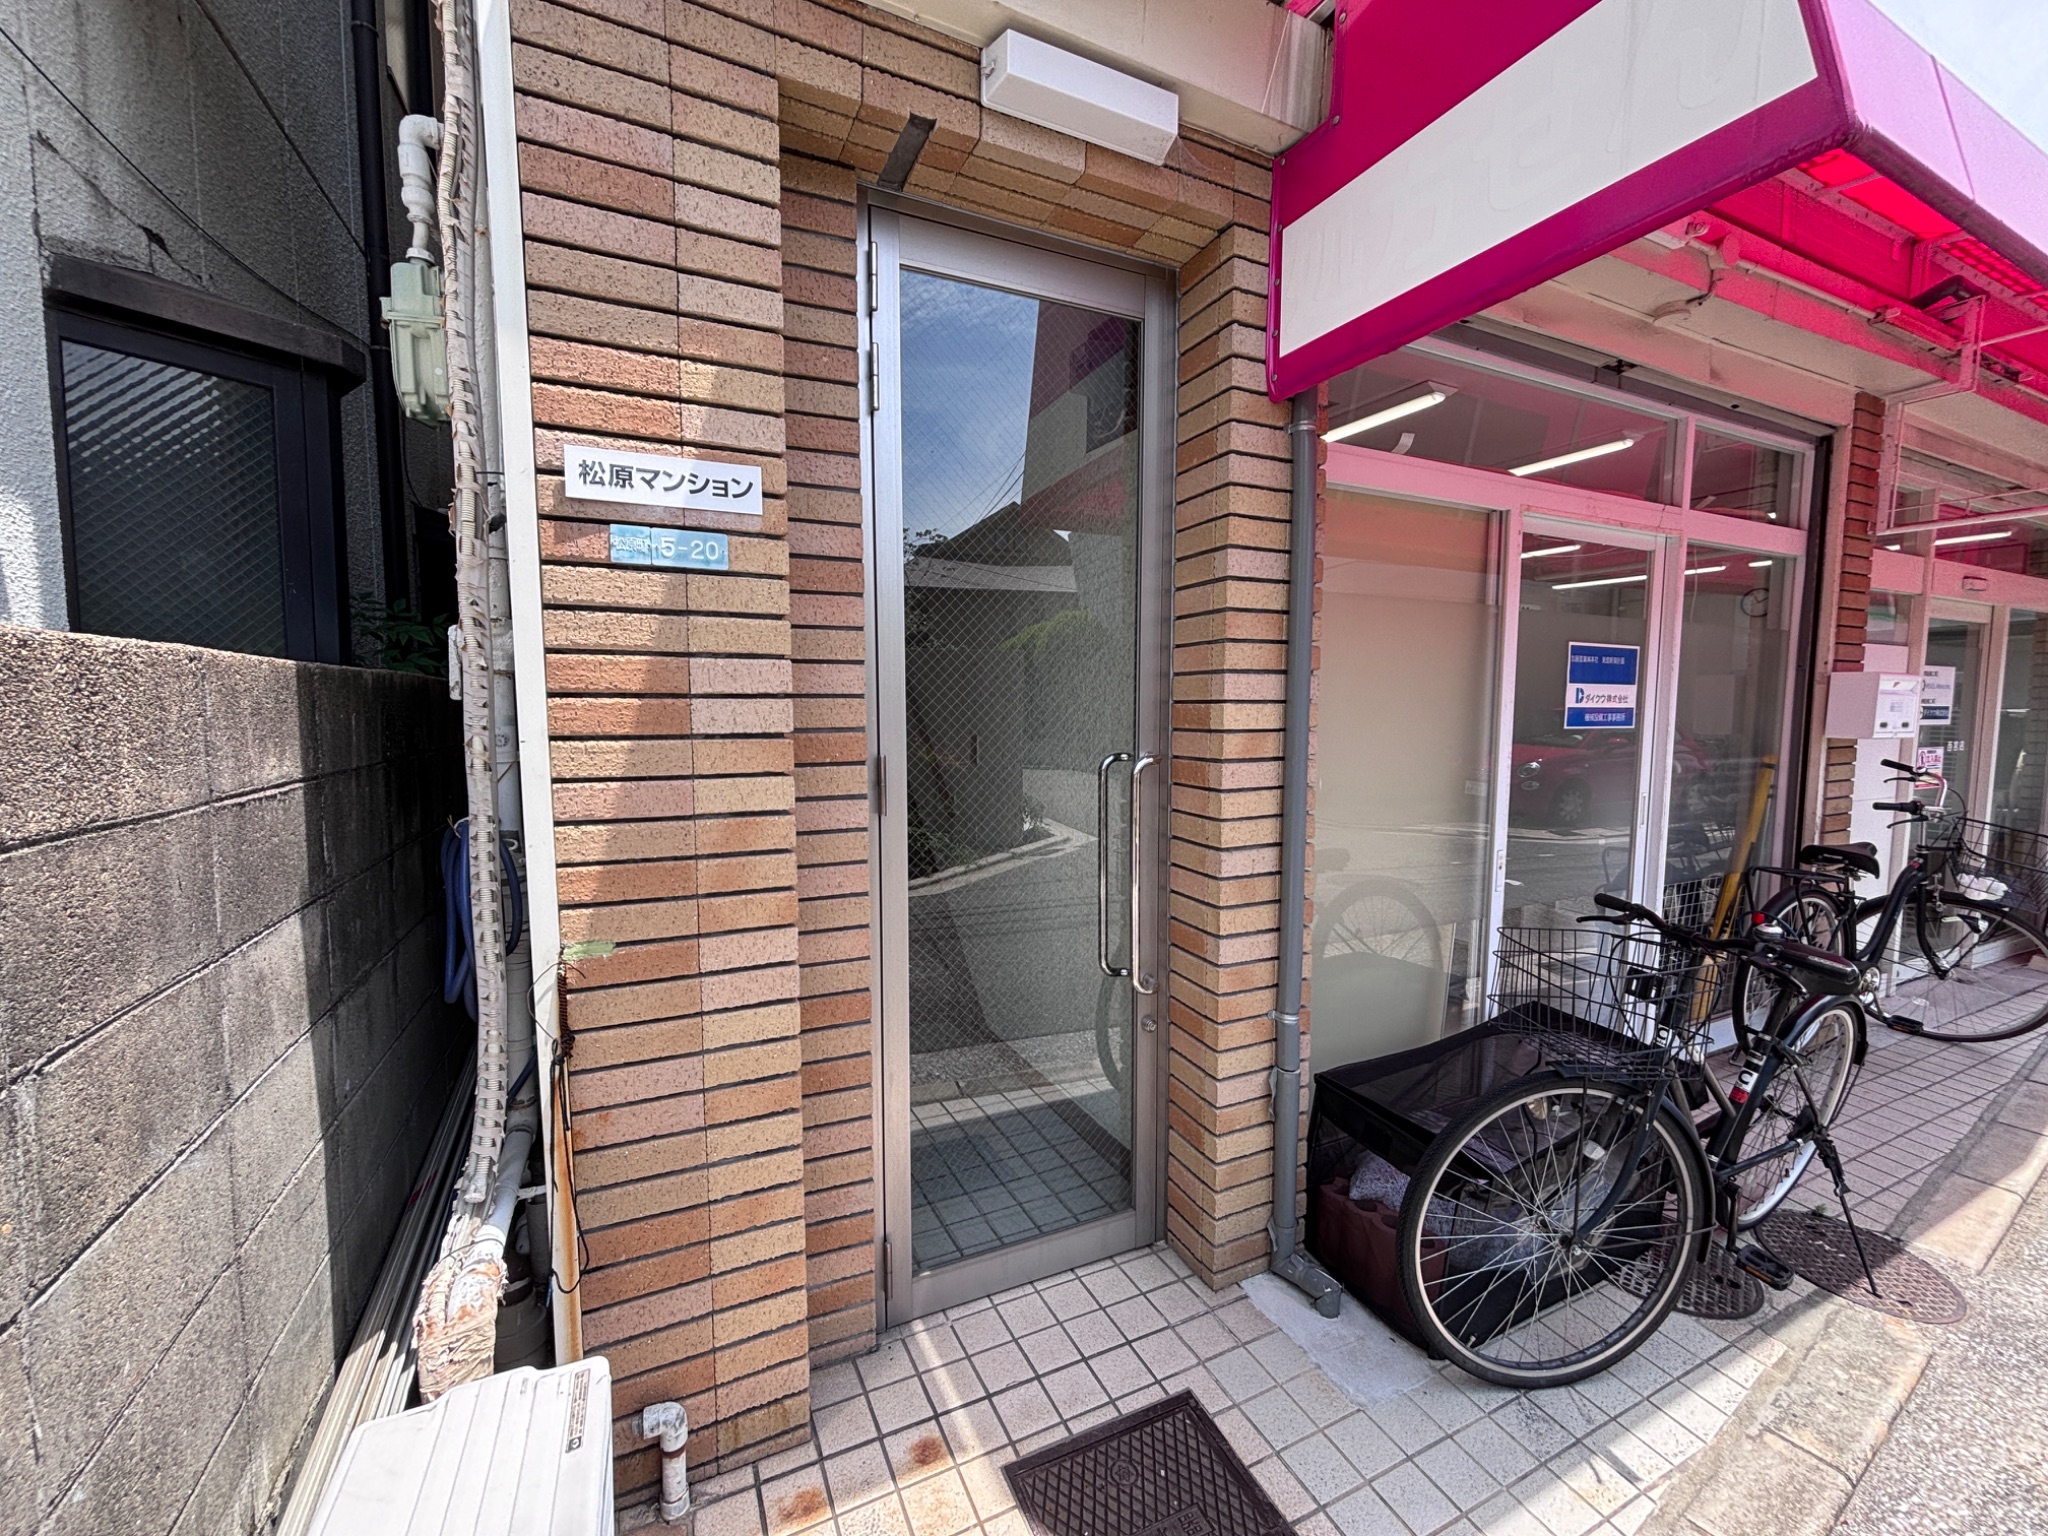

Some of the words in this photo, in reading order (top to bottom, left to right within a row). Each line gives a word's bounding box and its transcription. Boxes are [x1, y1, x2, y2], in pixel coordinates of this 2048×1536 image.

[578, 459, 754, 499] 松原マンション
[660, 537, 719, 560] 5-20
